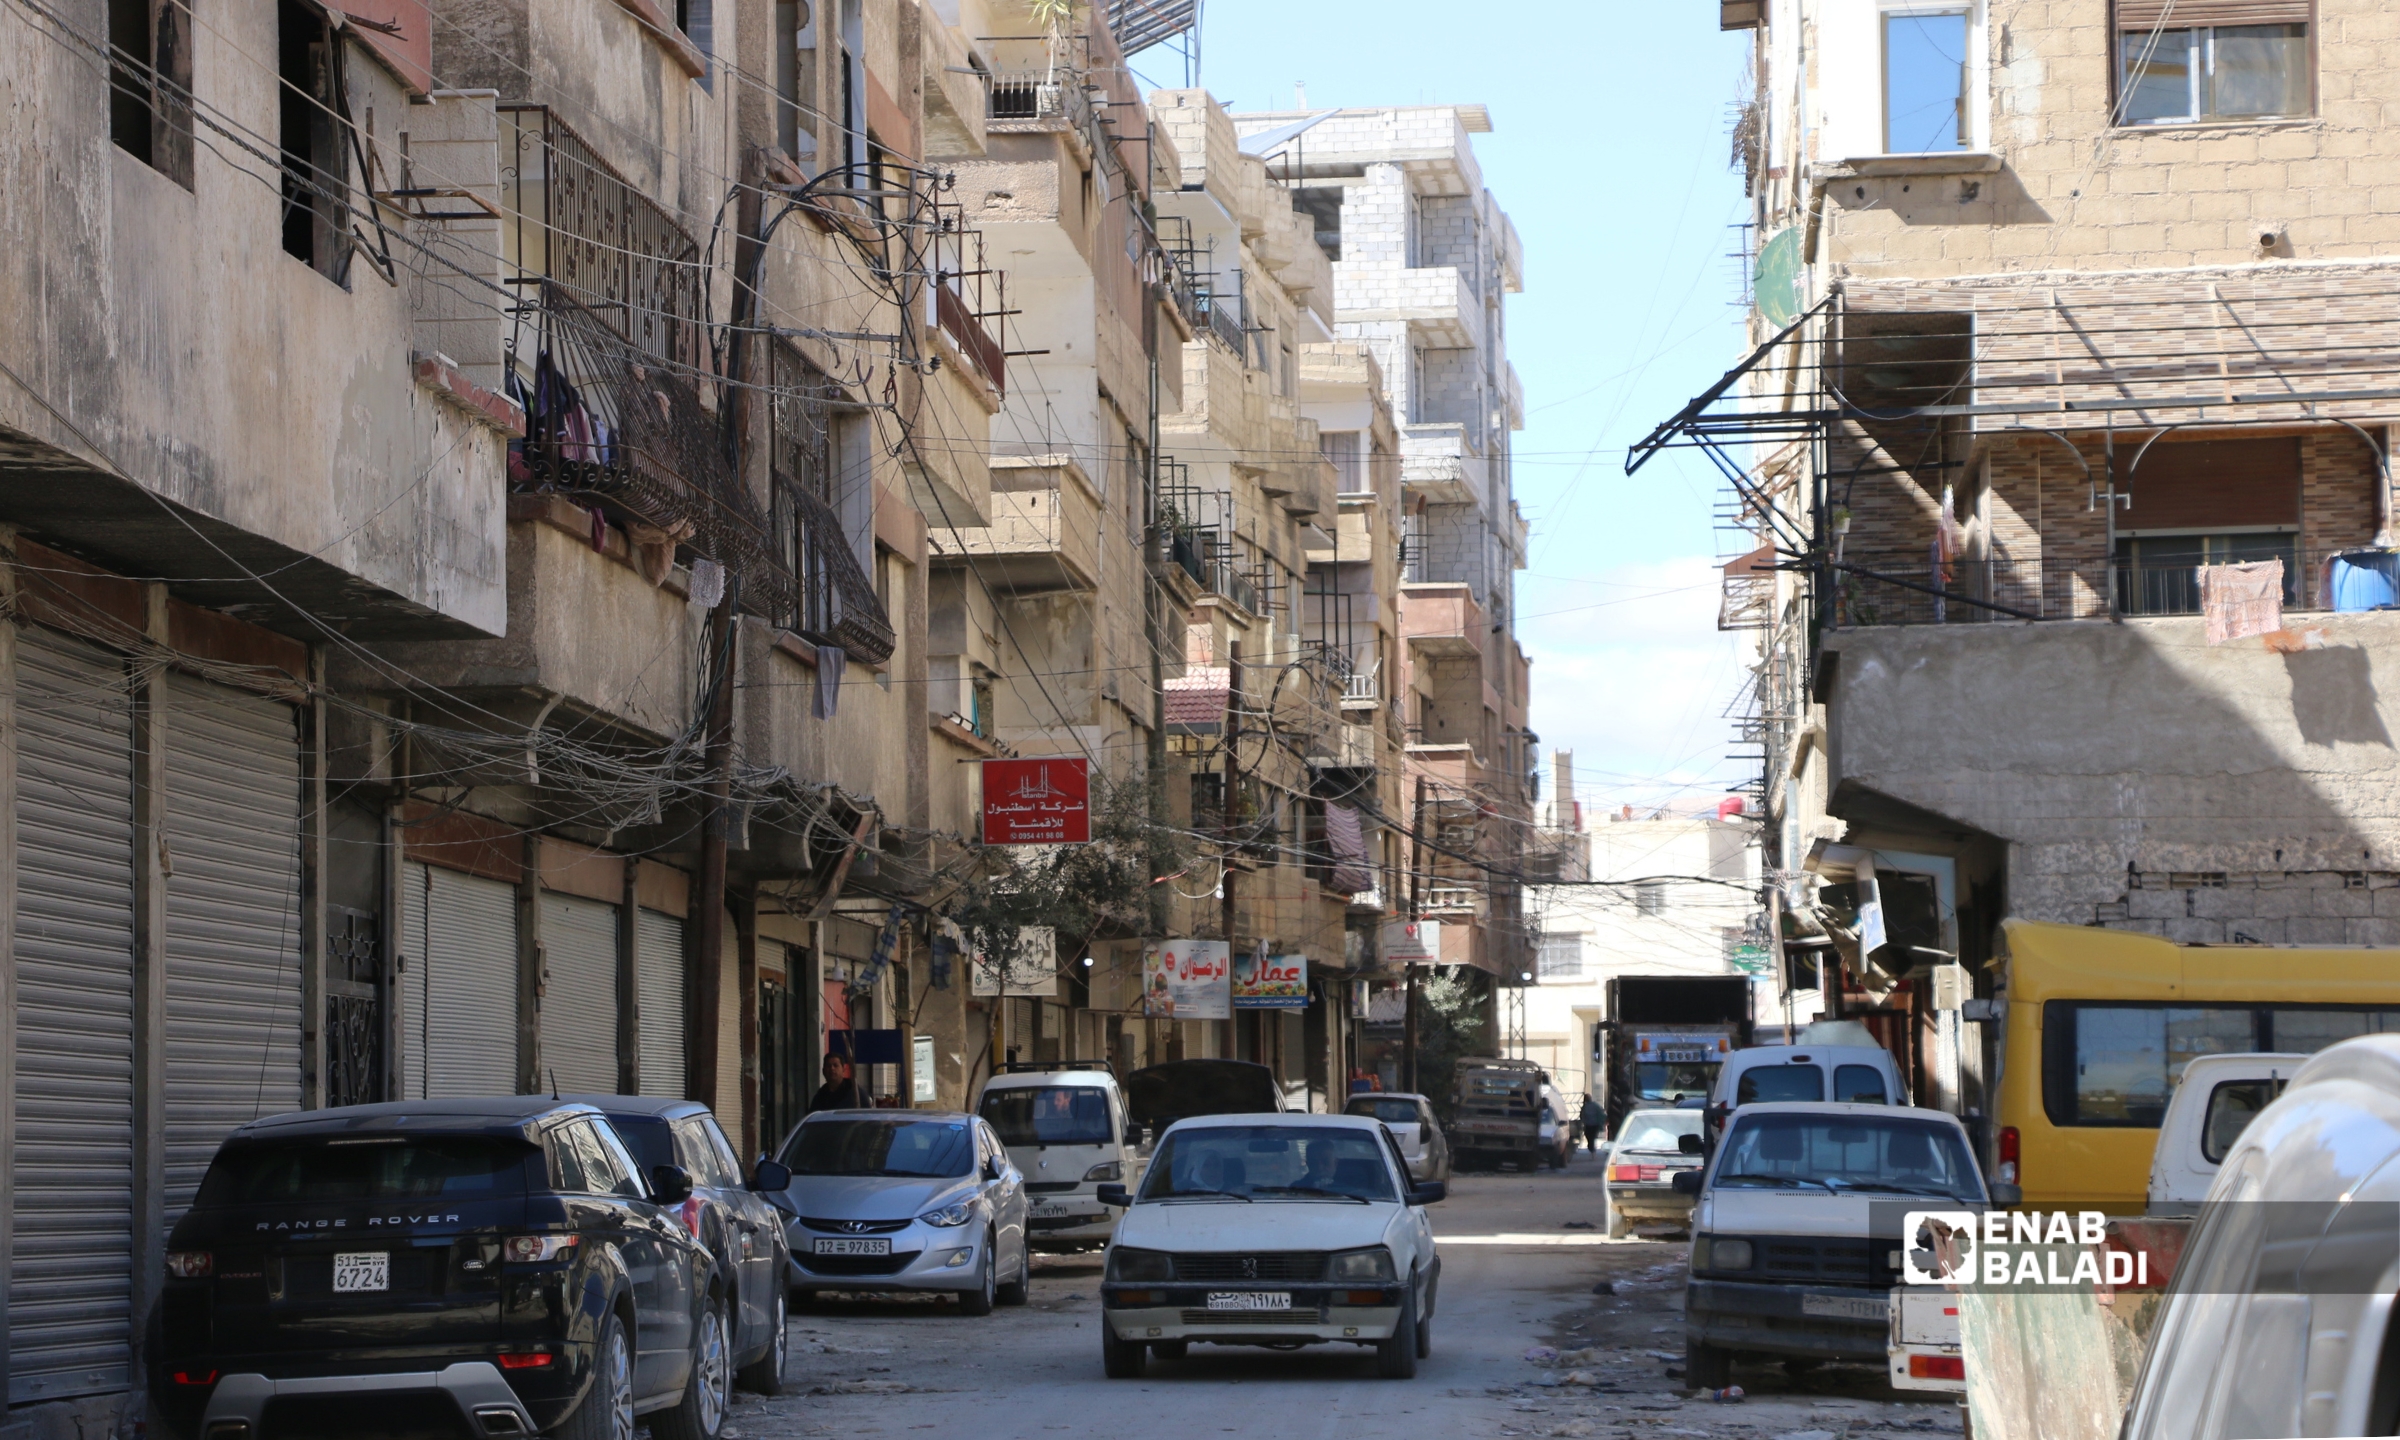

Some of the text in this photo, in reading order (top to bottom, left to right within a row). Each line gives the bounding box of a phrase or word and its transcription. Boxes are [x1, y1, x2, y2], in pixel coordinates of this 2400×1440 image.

[987, 800, 1085, 815] شركة اسطنبول
[1009, 816, 1064, 828] للأقمشة
[1180, 956, 1227, 981] الرضوان
[1243, 959, 1300, 987] عمار
[256, 1214, 460, 1231] RANGE ROVER
[819, 1241, 885, 1253] 12 97835
[337, 1256, 358, 1267] 511
[337, 1267, 385, 1288] 6724
[1250, 1293, 1289, 1308] ٦٩١٨٨٠
